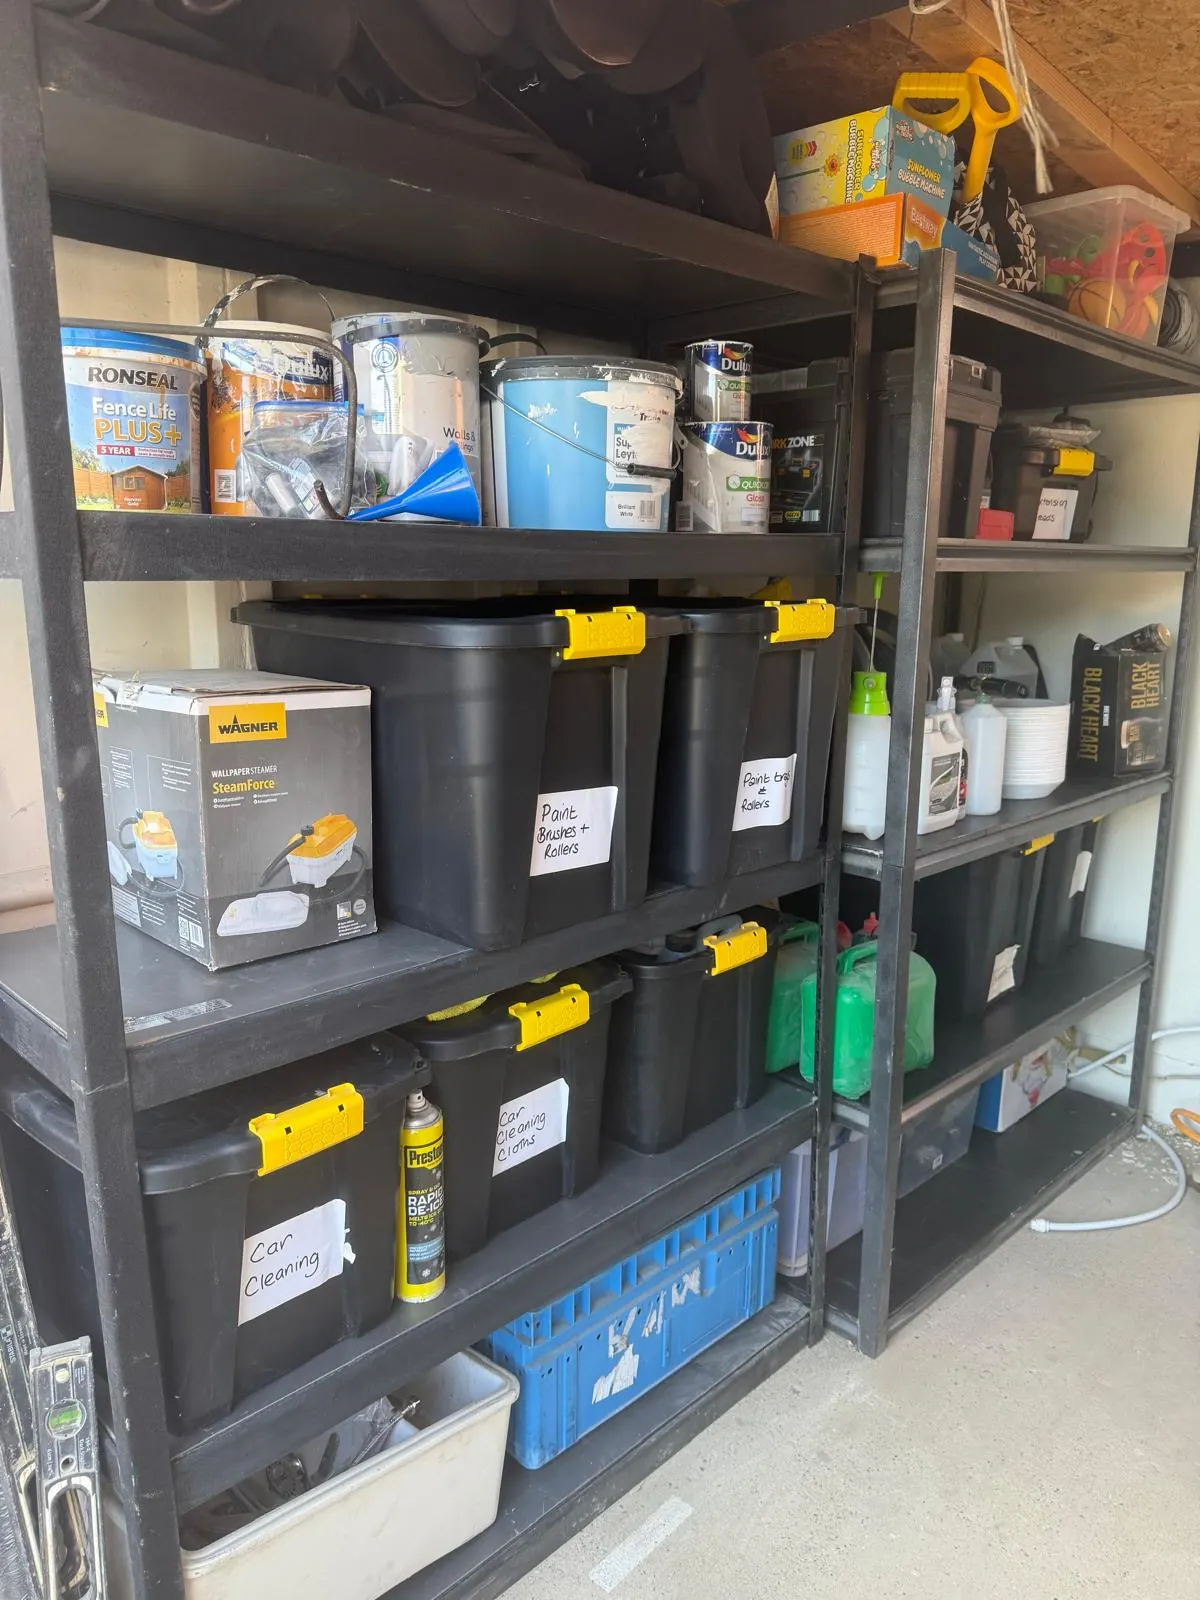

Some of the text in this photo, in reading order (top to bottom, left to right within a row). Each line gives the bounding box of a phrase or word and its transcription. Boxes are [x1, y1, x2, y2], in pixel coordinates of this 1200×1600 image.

[845, 119, 858, 203] BUBBLE MACHINE
[854, 129, 865, 190] SUNFLOWER
[907, 159, 941, 183] SUNFLOWER
[898, 169, 946, 199] BUBBLE MACHINE
[911, 207, 938, 239] Bestway
[721, 357, 752, 372] Dulux
[88, 367, 178, 390] RONSEAL
[92, 397, 177, 420] Fence Life
[94, 418, 182, 447] PLUS+
[443, 426, 471, 441] Walls
[100, 446, 107, 454] 5
[108, 446, 131, 455] YEAR
[736, 441, 769, 456] Dulux
[1037, 514, 1055, 522] eads
[1131, 662, 1147, 709] BLACK
[1146, 662, 1160, 708] HEART
[218, 714, 278, 734] WAGNER
[1079, 667, 1102, 762] BLACK HEART
[211, 765, 278, 778] WALLPAPER STEAMER
[744, 772, 770, 787] Paint
[212, 779, 275, 795] SteamForce
[541, 803, 578, 822] Paint
[741, 798, 770, 812] Rollers
[537, 823, 590, 844] Brushes +
[544, 843, 579, 860] Rollers
[499, 1106, 526, 1127] Car
[496, 1112, 546, 1145] Cleaning
[497, 1134, 536, 1162] Cloths
[408, 1186, 443, 1206] RAPID
[250, 1233, 293, 1263] Car
[244, 1251, 319, 1297] Cleaning
